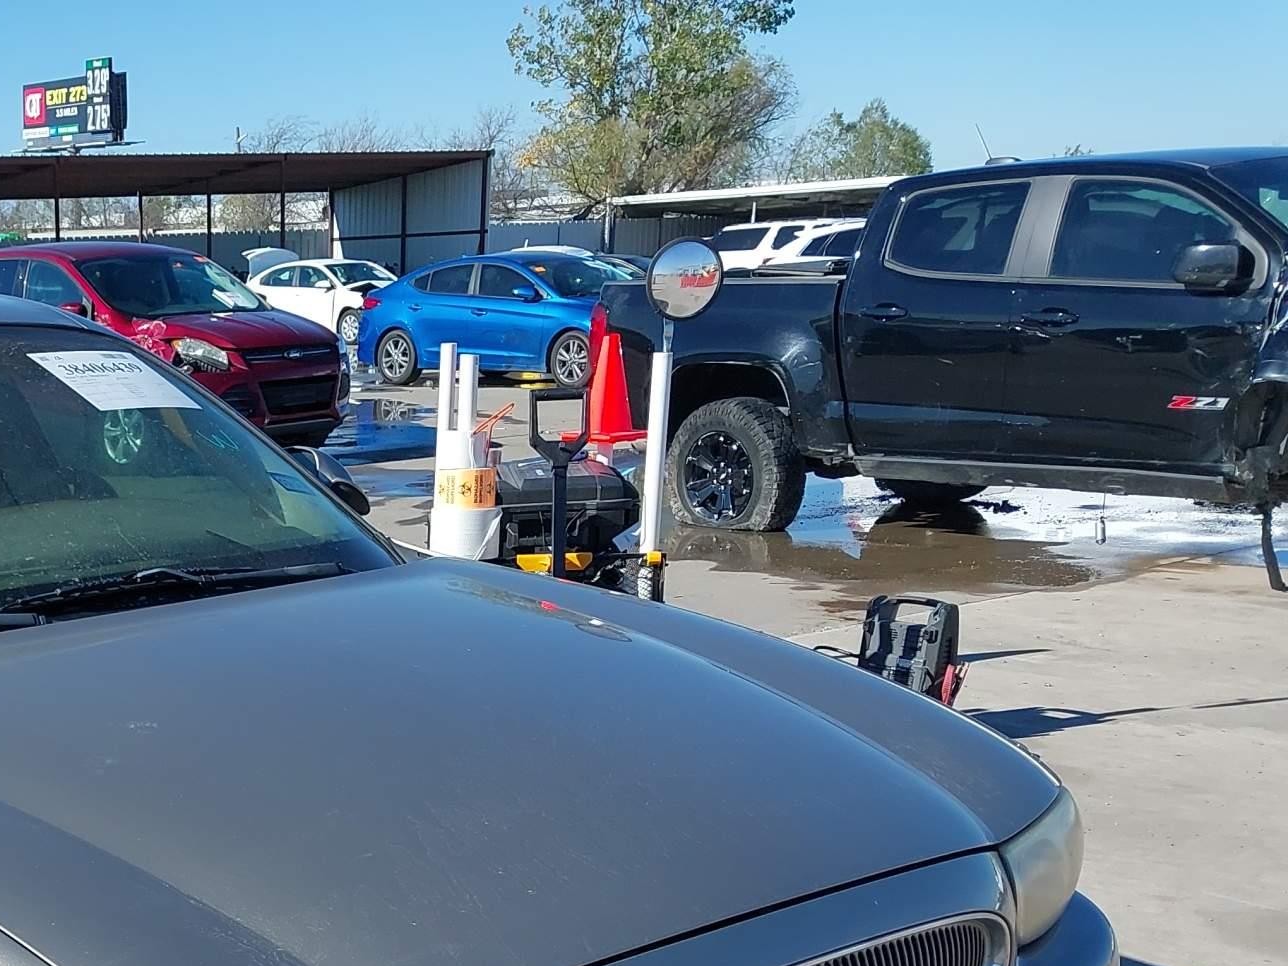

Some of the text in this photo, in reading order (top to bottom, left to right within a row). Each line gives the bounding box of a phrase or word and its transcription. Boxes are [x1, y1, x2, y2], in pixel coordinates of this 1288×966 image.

[46, 85, 87, 106] EXIT 273
[57, 362, 143, 376] 38406439
[1167, 395, 1231, 411] Z71
